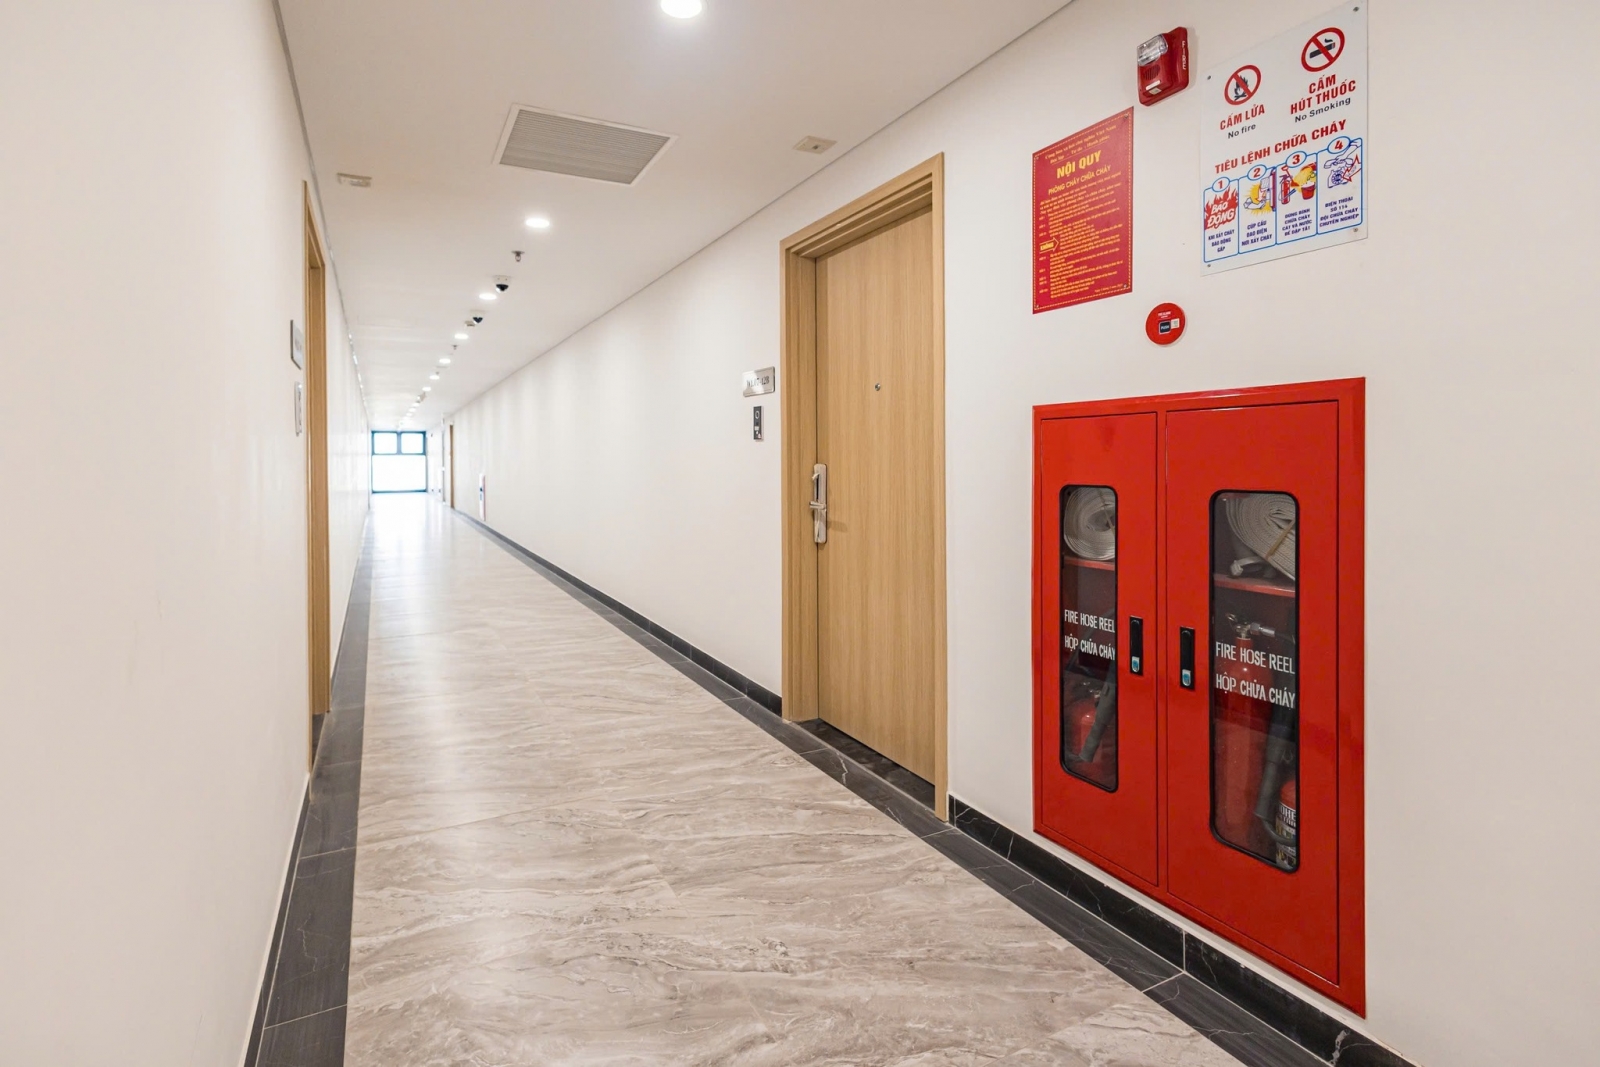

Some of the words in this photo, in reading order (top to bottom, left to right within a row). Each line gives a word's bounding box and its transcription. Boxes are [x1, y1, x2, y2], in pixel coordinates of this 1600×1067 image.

[1309, 74, 1336, 94] CẤM
[1290, 96, 1313, 115] HÚT
[1316, 79, 1356, 105] THUỐC
[1220, 113, 1242, 130] CẤM
[1245, 104, 1265, 121] LỬA
[1295, 112, 1307, 123] No
[1309, 97, 1351, 118] Smoking
[1228, 130, 1239, 139] No
[1241, 123, 1256, 134] fire
[1215, 157, 1238, 174] TIÊU
[1241, 147, 1270, 166] LỆNH
[1274, 134, 1307, 154] CHỮA
[1311, 119, 1346, 140] CHÁY
[1334, 140, 1343, 150] 4
[1056, 161, 1076, 179] NỘI
[1079, 150, 1102, 170] QUY
[1292, 154, 1300, 165] 3
[1253, 167, 1261, 177] 2
[1218, 180, 1223, 189] 1
[1211, 201, 1228, 214] BÁO
[1064, 609, 1078, 624] FIRE
[1080, 612, 1097, 629] HOSE
[1099, 616, 1115, 633] REEL
[1099, 643, 1115, 660] CHÁY
[1215, 641, 1237, 661] FIRE
[1240, 647, 1266, 668] HOSE
[1269, 653, 1295, 675] REEL
[1216, 671, 1237, 694] HỘP
[1269, 687, 1295, 709] CHÁY
